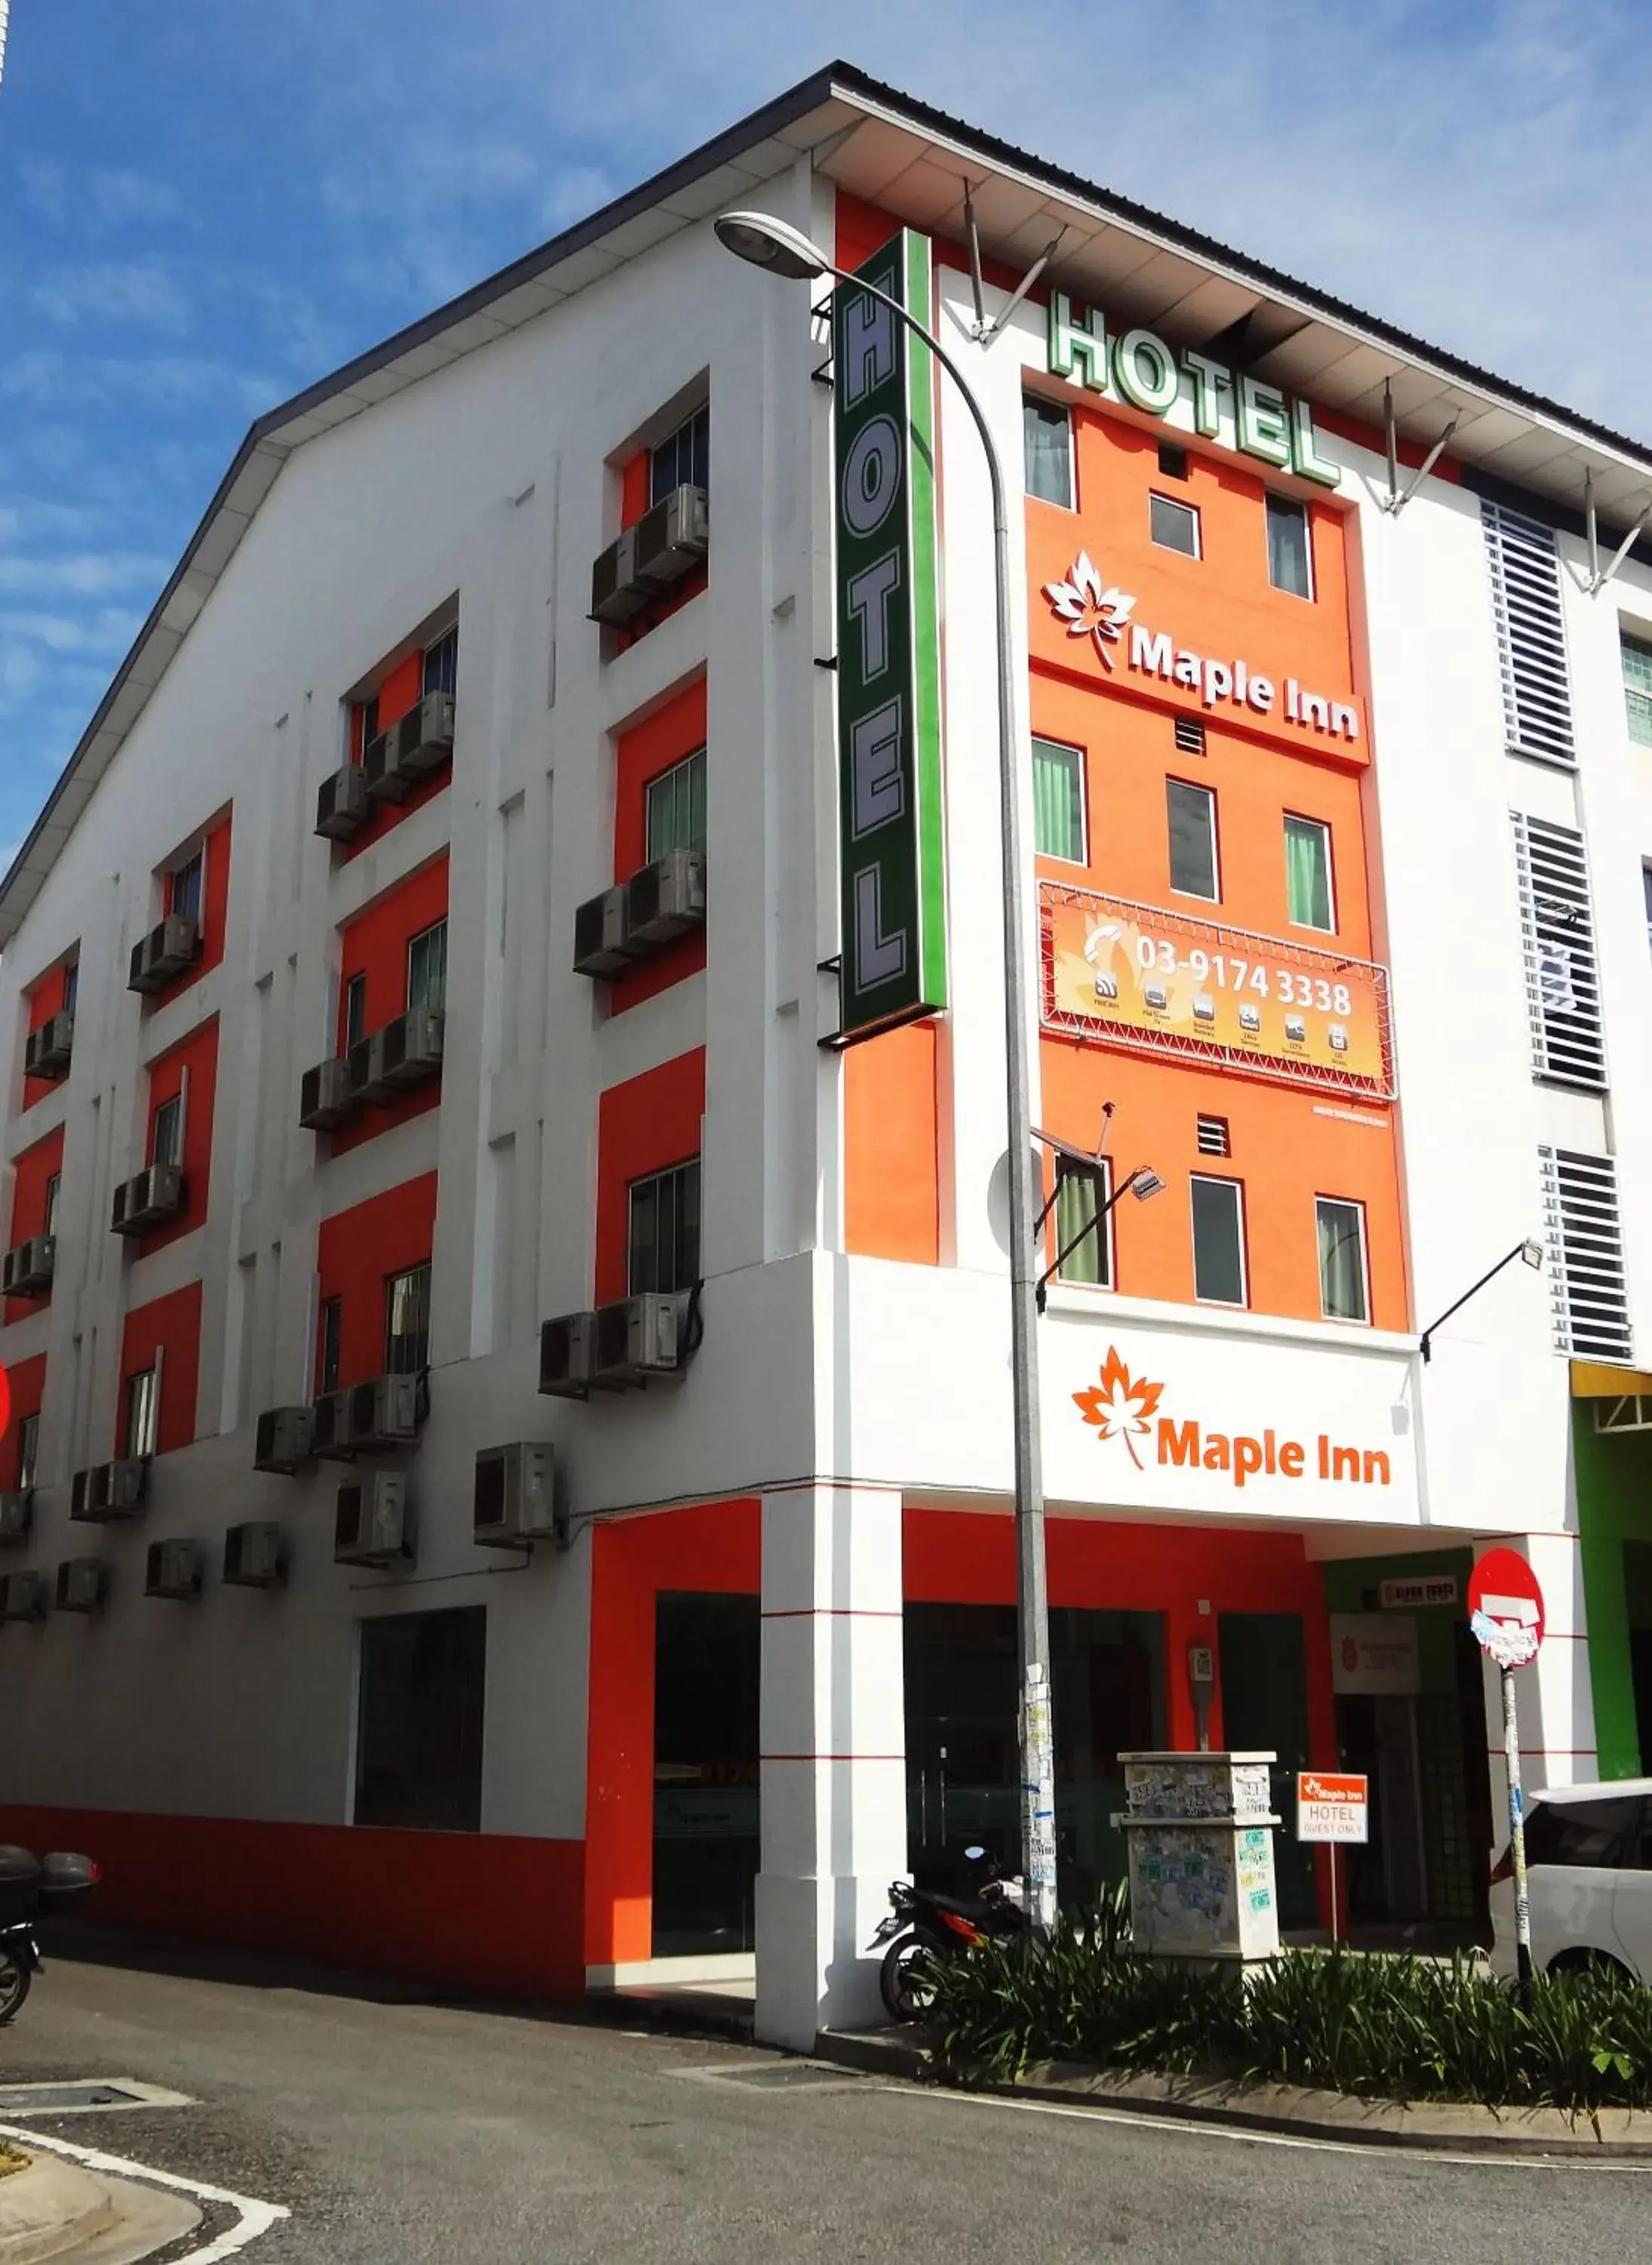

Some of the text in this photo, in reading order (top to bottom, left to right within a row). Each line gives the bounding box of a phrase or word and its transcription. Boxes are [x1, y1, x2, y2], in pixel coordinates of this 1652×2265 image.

[1049, 289, 1340, 488] HOTEL
[843, 264, 905, 996] HOTEL
[1129, 624, 1359, 742] Maple Inn
[1136, 935, 1351, 1015] 03-9174 3338
[1157, 1418, 1390, 1487] Maple Inn
[1310, 1805, 1356, 1820] HOTEL
